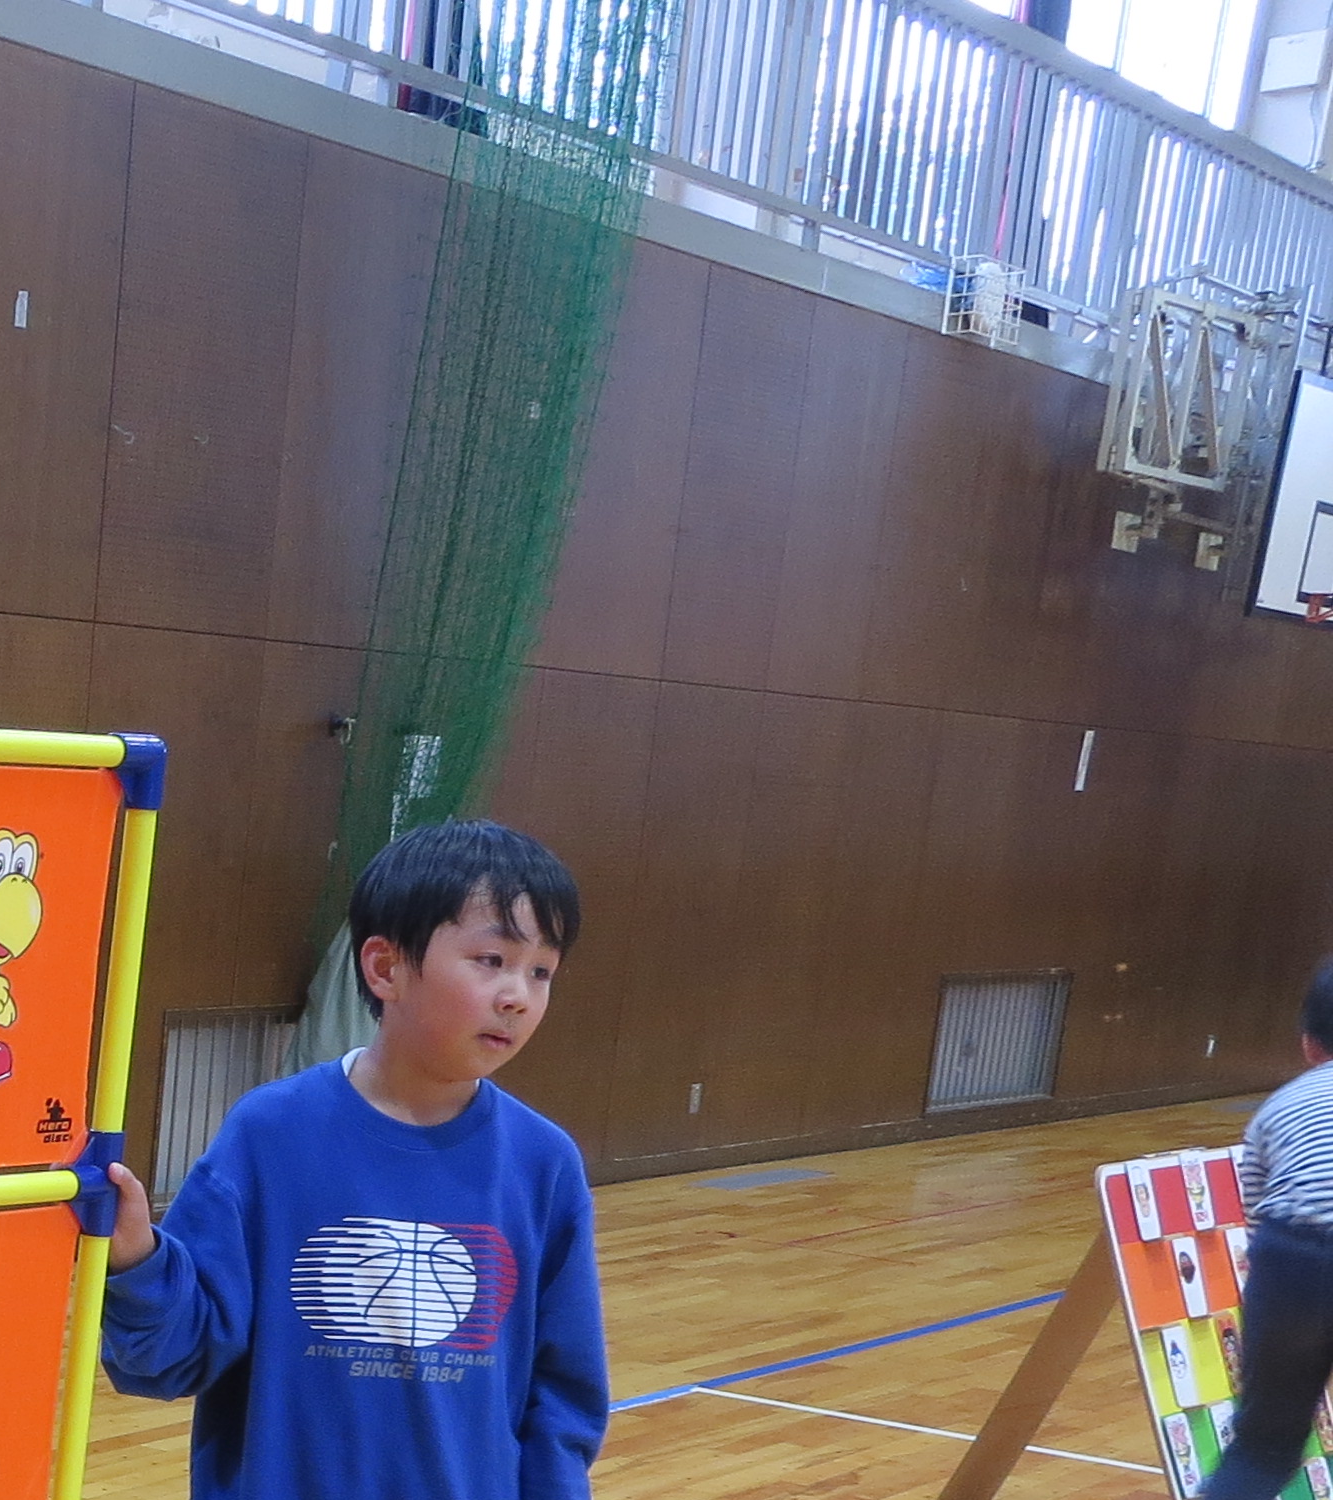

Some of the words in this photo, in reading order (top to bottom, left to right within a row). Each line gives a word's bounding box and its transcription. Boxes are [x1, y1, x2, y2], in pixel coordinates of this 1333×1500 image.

[38, 1119, 70, 1132] Hero
[304, 1344, 395, 1359] ATHLETICS
[400, 1349, 440, 1363] CLUB
[349, 1360, 416, 1380] SINCE
[421, 1365, 465, 1383] 1984
